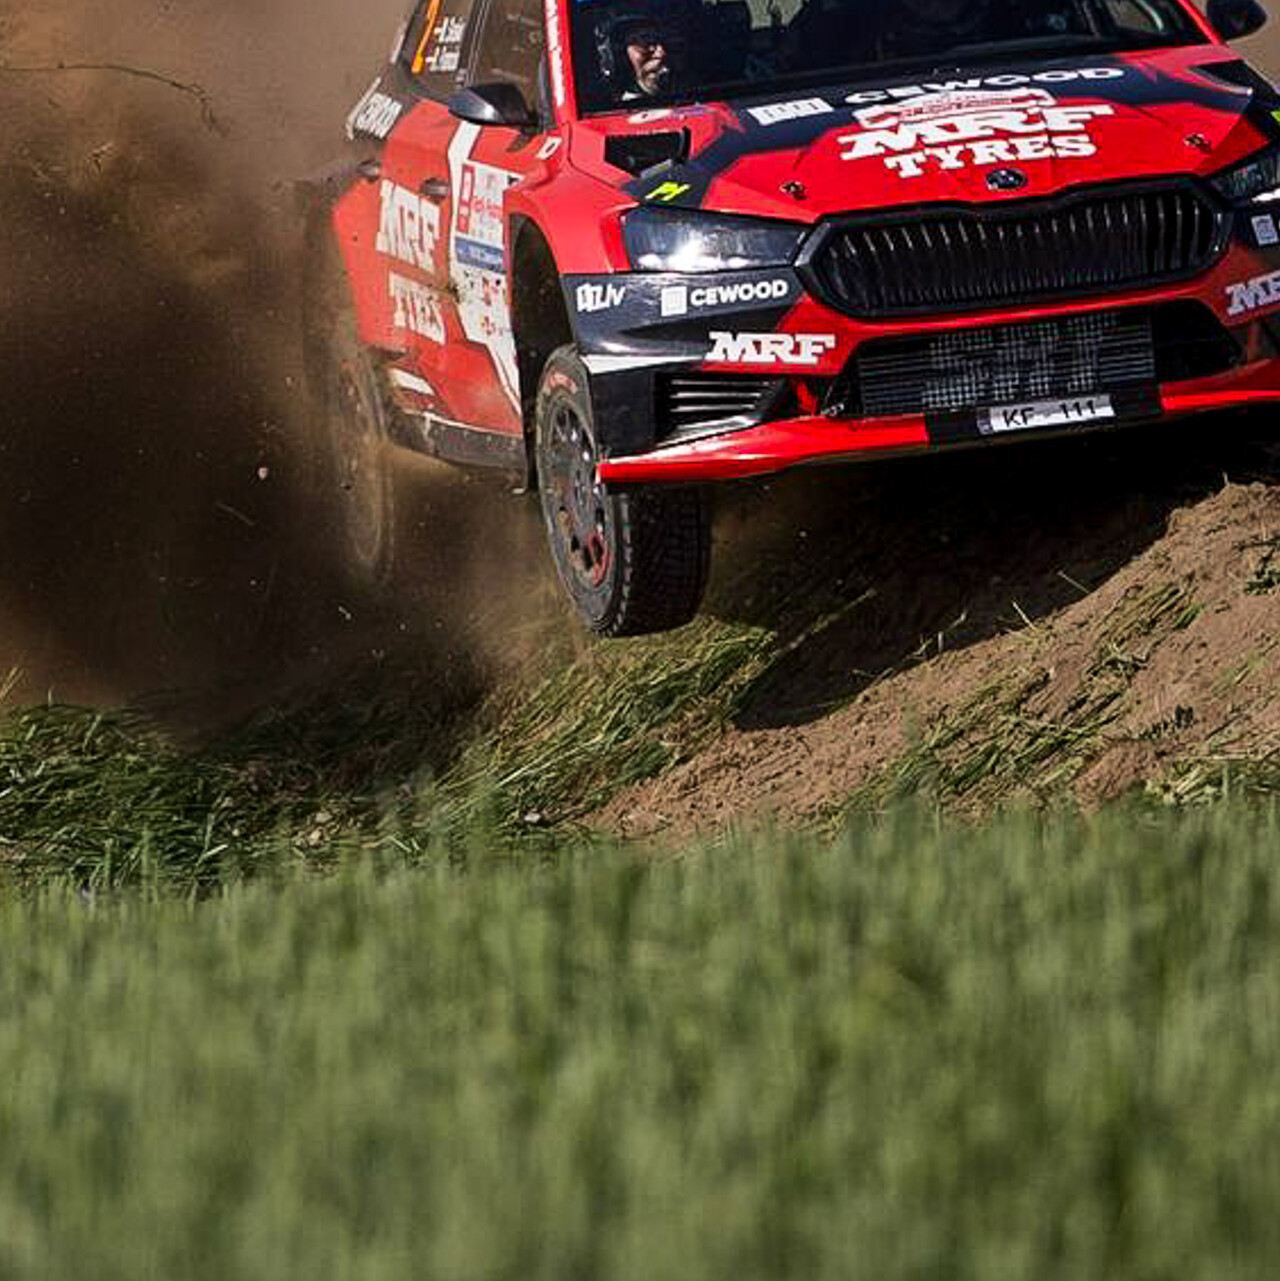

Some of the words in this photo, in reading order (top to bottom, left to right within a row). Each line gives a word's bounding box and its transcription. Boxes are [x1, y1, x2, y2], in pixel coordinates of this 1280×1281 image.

[837, 104, 1115, 160] MRF
[884, 134, 1098, 179] TYRES
[375, 178, 441, 276] MRF
[690, 279, 789, 308] CEWOOD
[704, 330, 836, 364] MRF
[1002, 407, 1034, 428] KF
